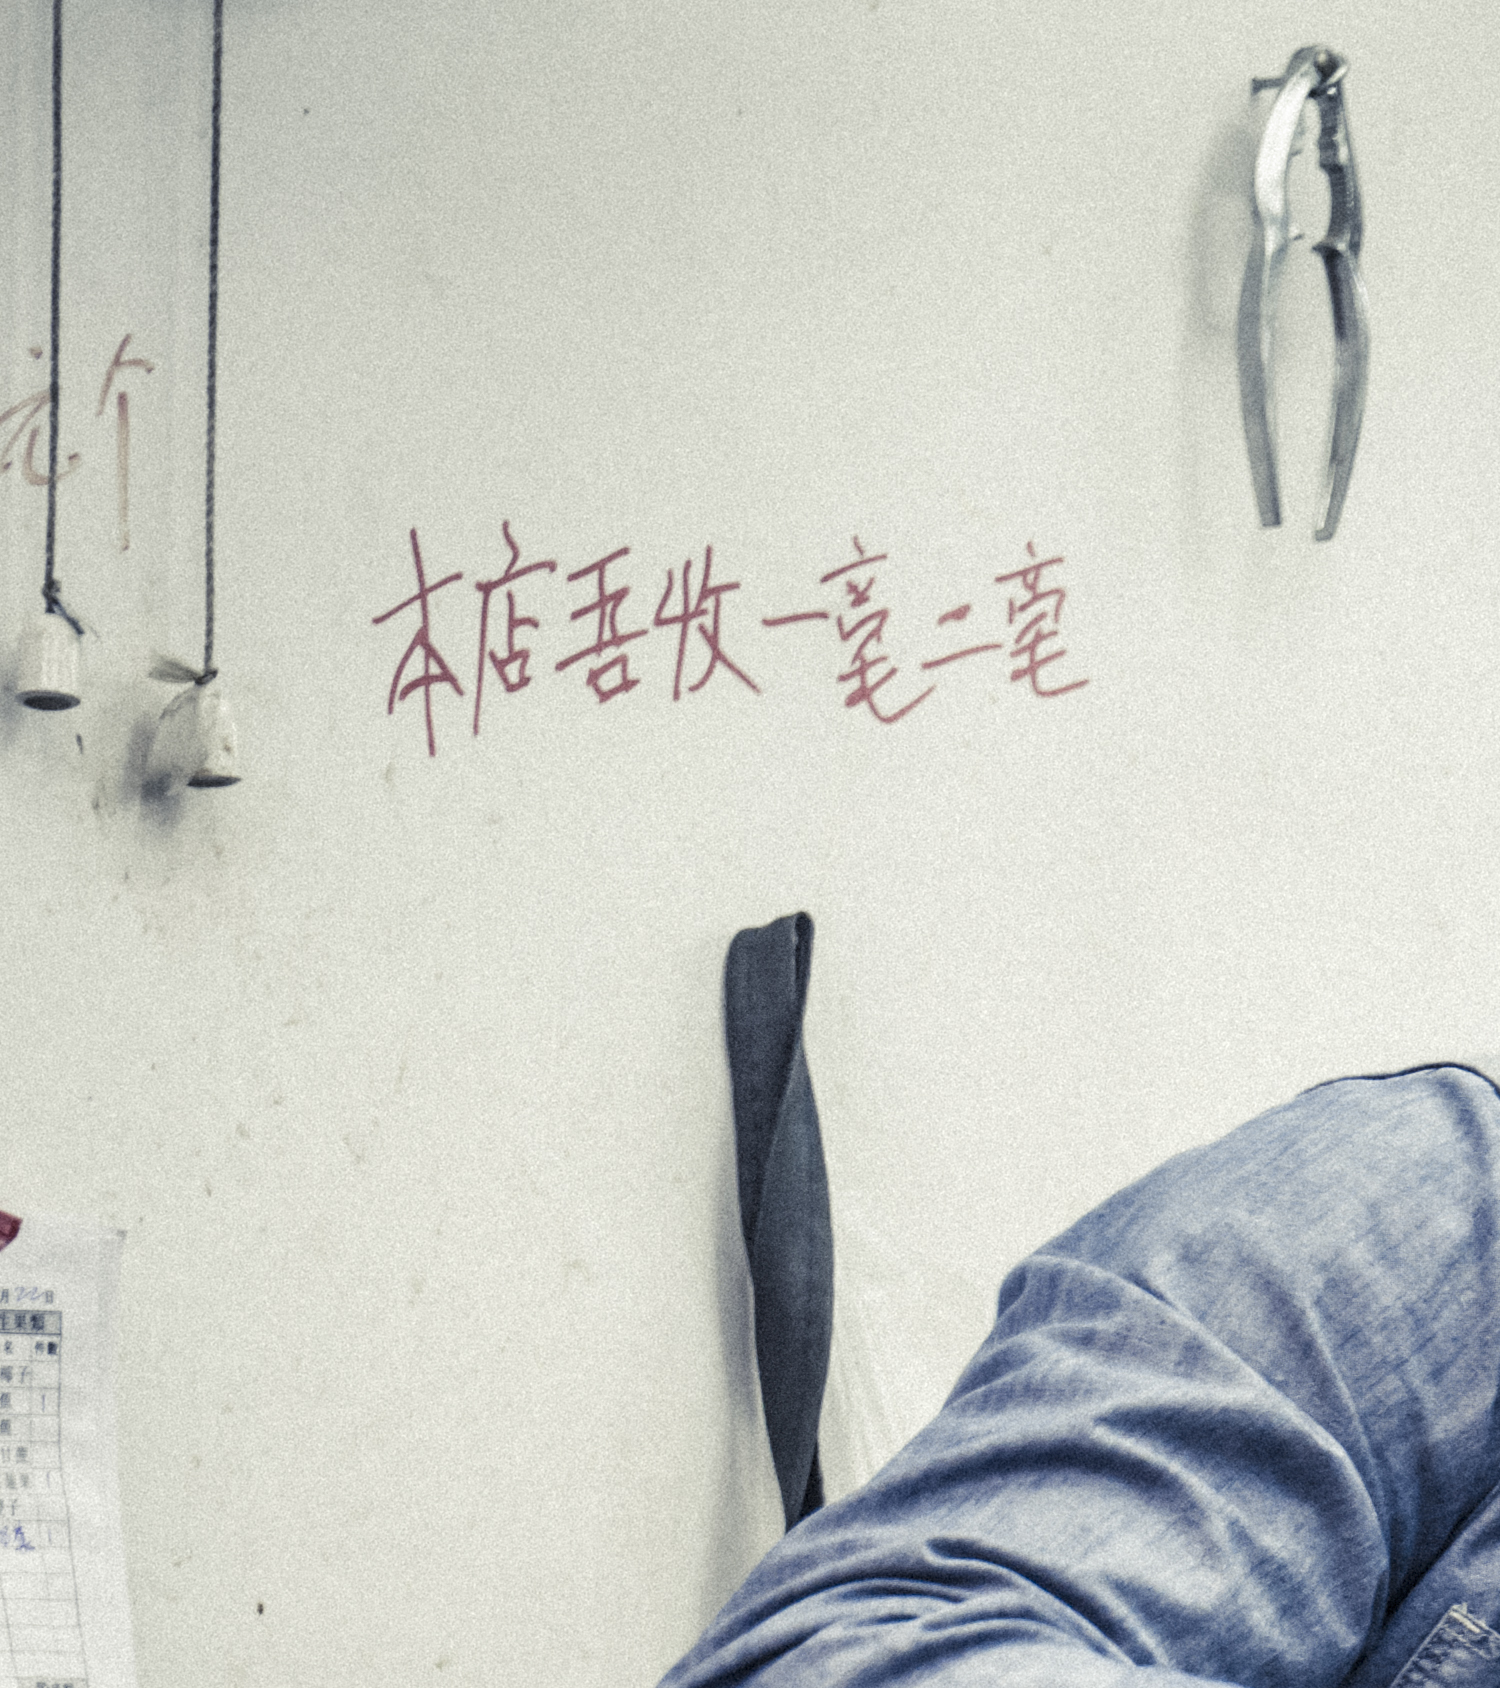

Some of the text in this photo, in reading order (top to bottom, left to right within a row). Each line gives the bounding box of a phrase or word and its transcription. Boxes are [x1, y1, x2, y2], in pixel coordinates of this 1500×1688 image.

[372, 520, 1090, 757] 本店吾收一毫二毫
